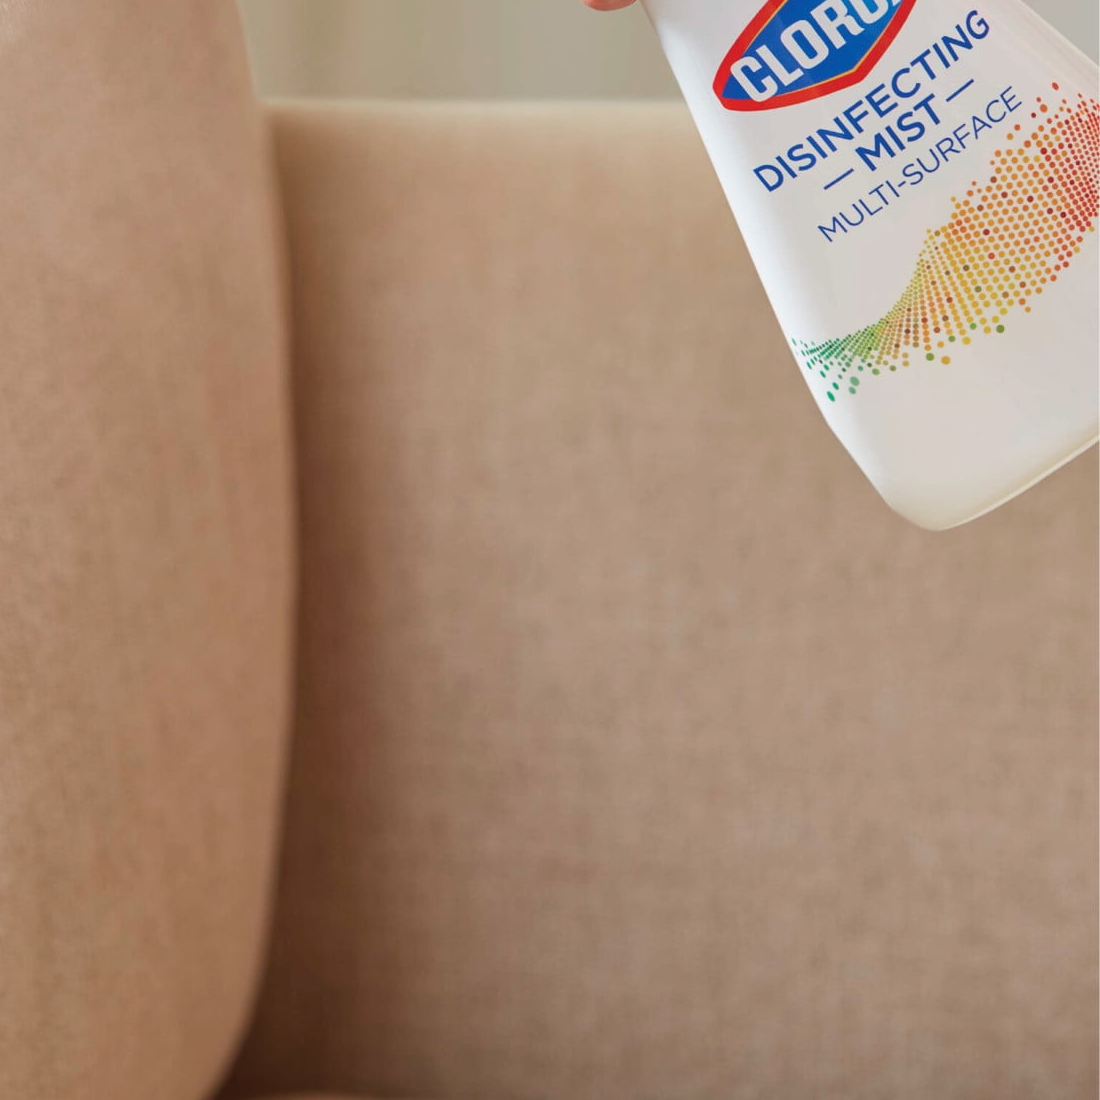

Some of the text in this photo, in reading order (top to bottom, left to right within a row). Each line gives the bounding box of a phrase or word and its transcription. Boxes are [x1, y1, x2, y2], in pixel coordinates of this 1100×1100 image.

[753, 10, 990, 192] DISINFECTING
[817, 86, 1022, 242] MULTI-SURFACE
[855, 93, 941, 172] MIST
